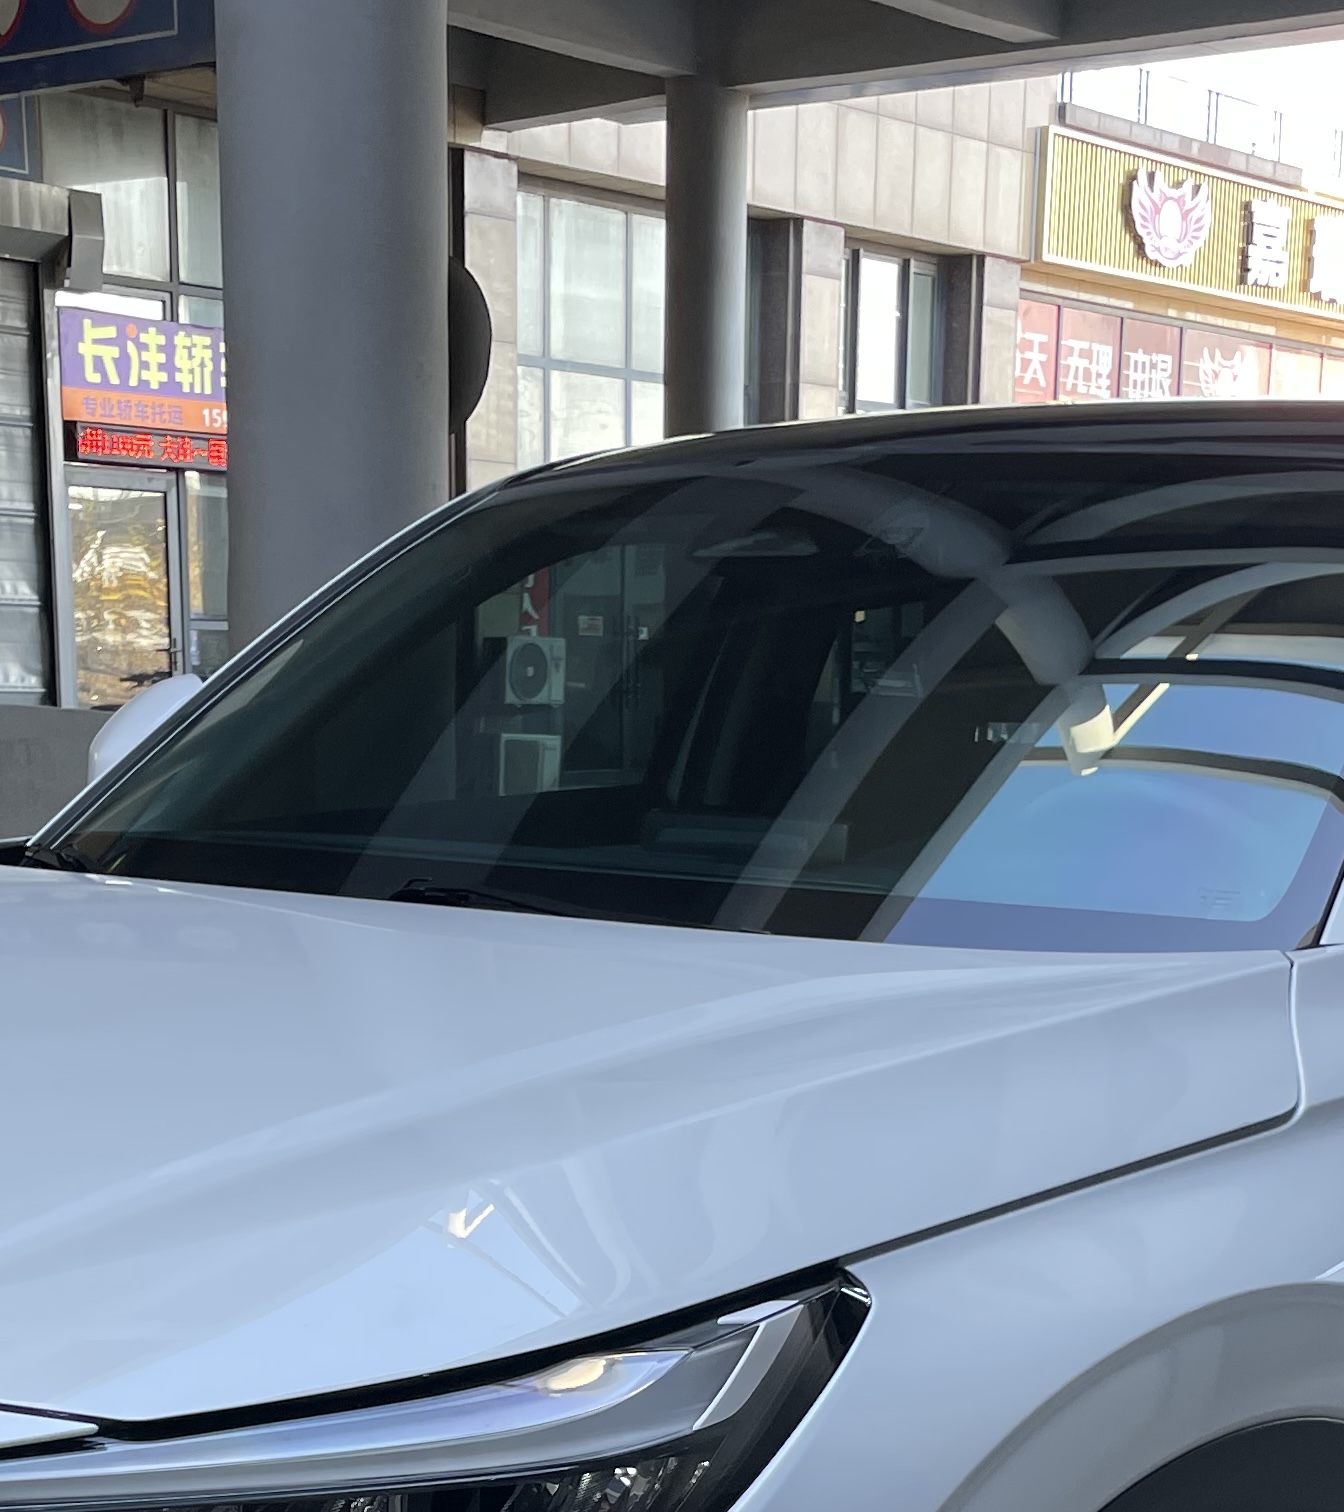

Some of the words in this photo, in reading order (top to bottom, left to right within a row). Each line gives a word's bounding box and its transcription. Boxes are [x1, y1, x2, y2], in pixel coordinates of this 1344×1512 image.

[78, 318, 226, 394] 长沣轿
[82, 395, 184, 425] 专业轿车托运
